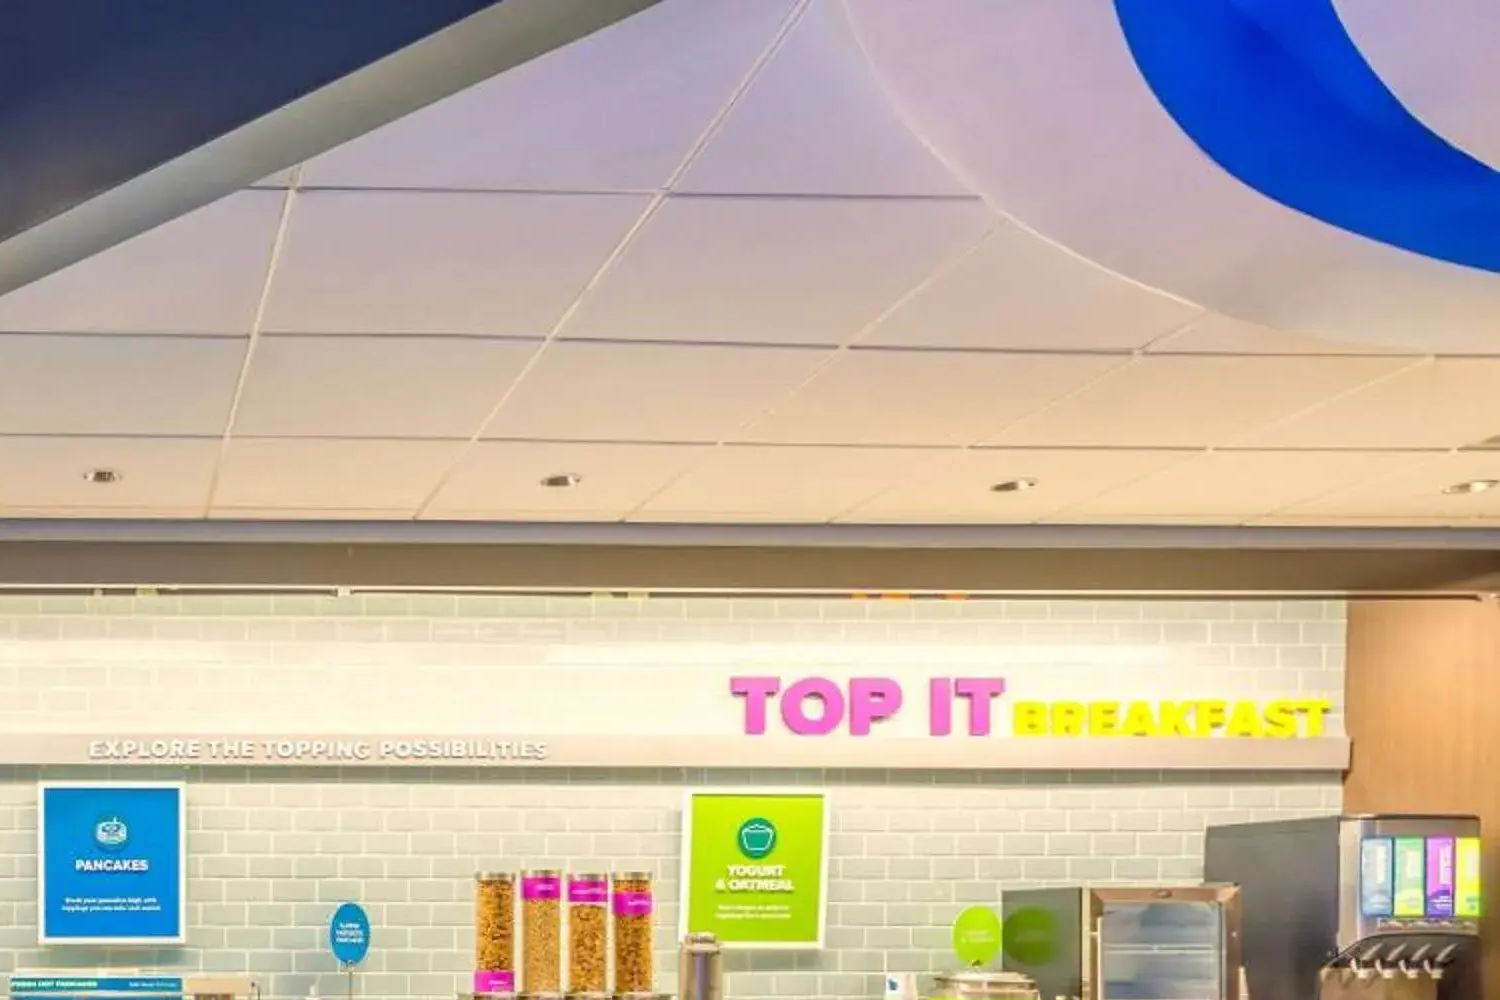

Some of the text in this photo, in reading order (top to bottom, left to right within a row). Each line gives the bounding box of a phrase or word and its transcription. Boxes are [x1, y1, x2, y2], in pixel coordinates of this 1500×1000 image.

[730, 676, 1331, 739] TOP IT BREAKFAST
[88, 740, 548, 761] EXPLORE THE TOPPING POSSIBILITIES
[75, 859, 149, 873] PANCAKES
[726, 864, 786, 877] YOGURT
[728, 879, 794, 892] OATMEAL
